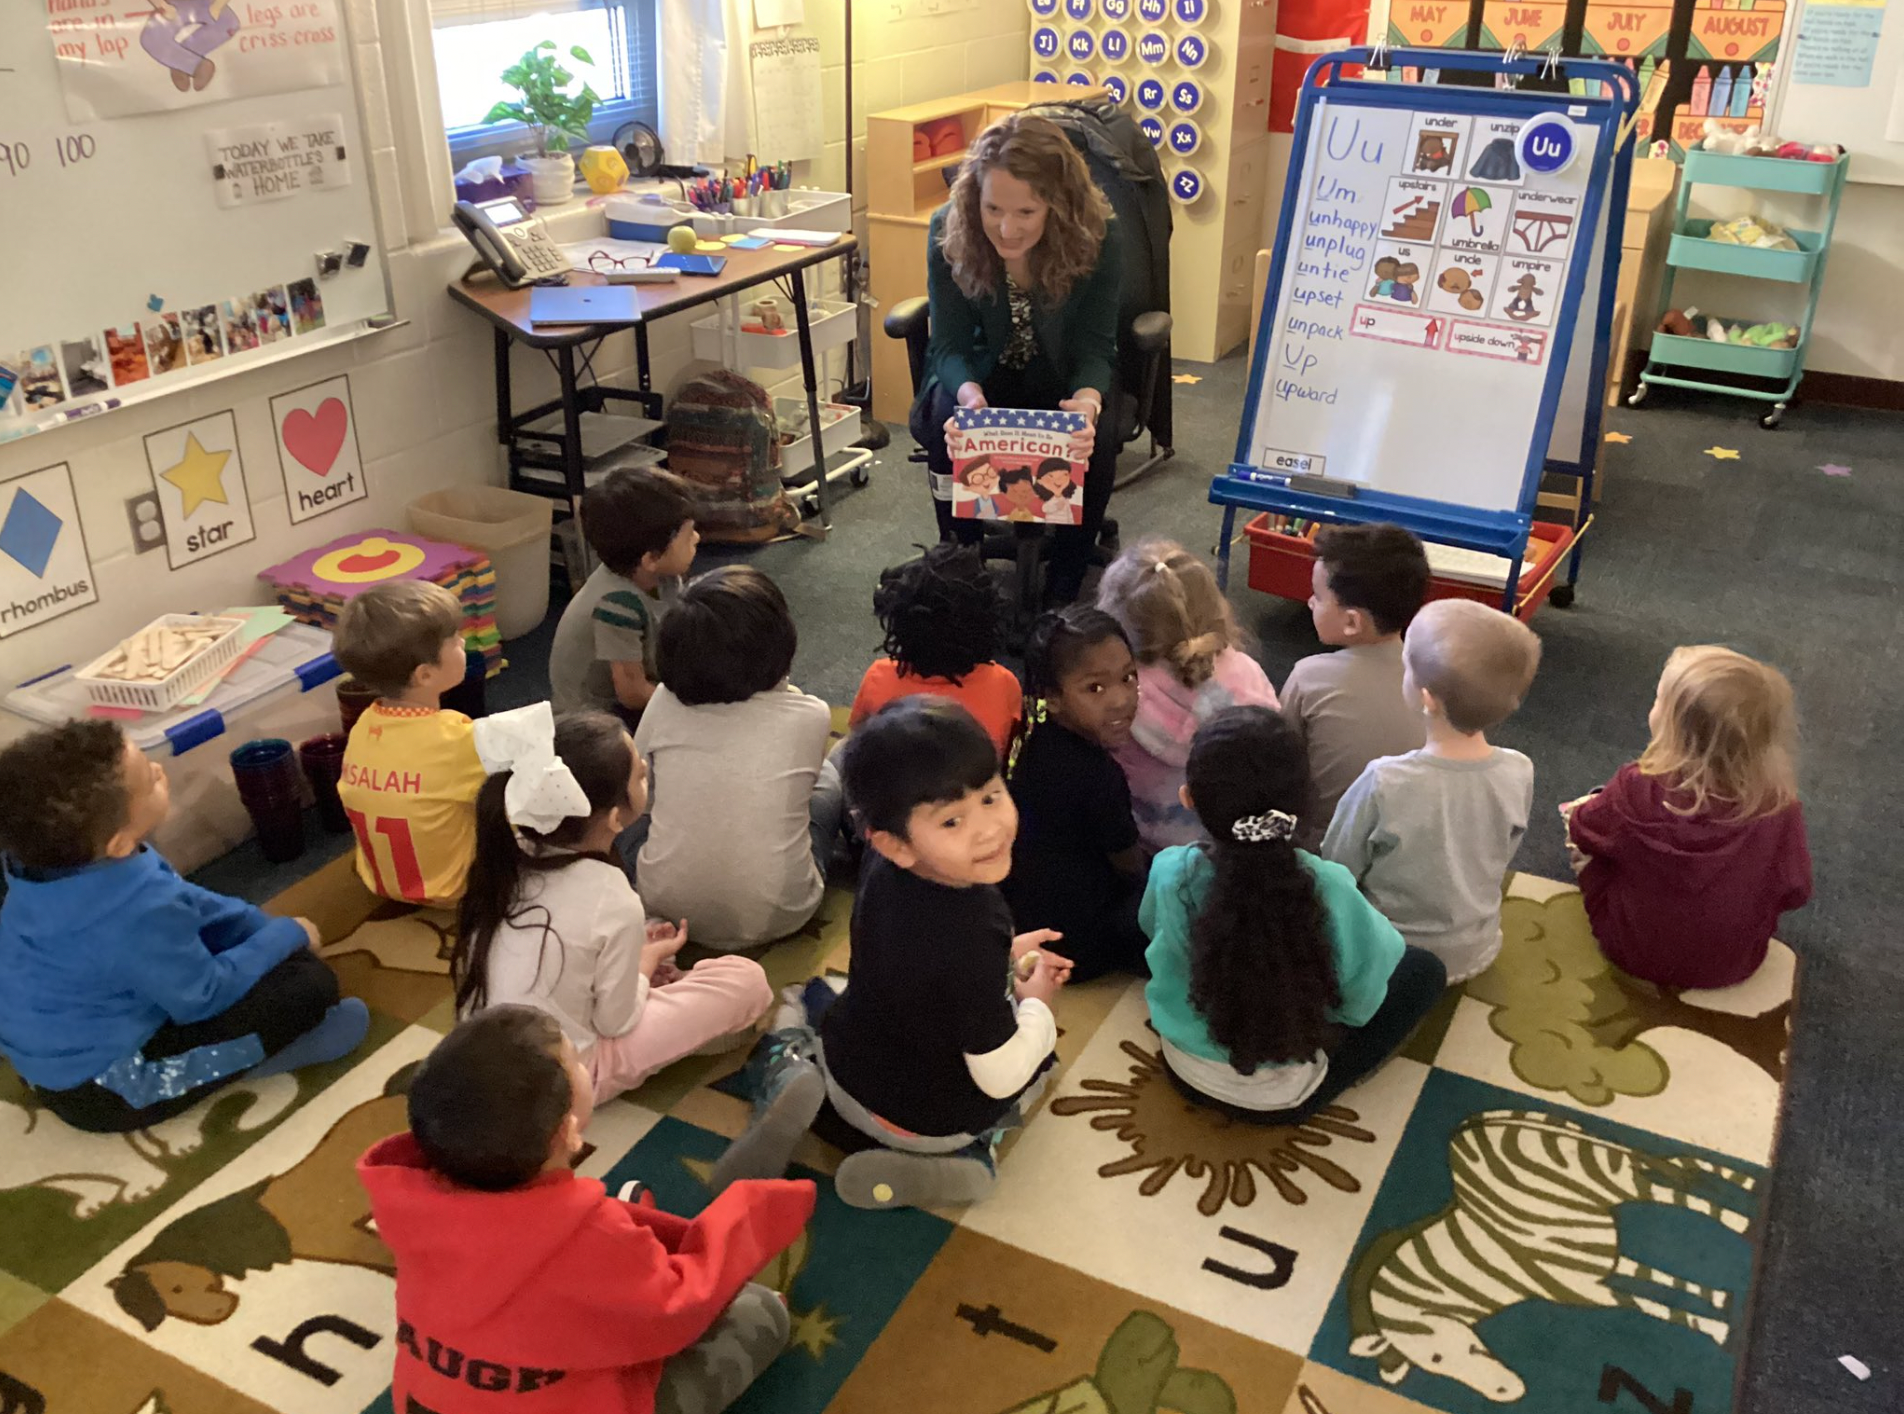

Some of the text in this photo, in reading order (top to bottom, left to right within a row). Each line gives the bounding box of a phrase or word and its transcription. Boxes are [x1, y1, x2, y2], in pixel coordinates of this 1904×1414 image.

[246, 3, 320, 29] legs are
[1410, 5, 1770, 37] MAY JUNE JULY AUGUST
[58, 33, 129, 67] my lap
[239, 26, 336, 53] criss cross
[1039, 35, 1053, 51] Jj
[1072, 37, 1089, 52] Kk
[1141, 41, 1163, 56] Mm
[1181, 40, 1198, 61] Nn
[1143, 87, 1157, 100] Rr
[1178, 88, 1193, 104] Ss
[1424, 116, 1458, 128] under
[1490, 122, 1520, 136] unzip
[218, 130, 335, 162] TODAY WE TAKE
[1176, 131, 1192, 144] Xx
[1326, 116, 1383, 164] Uu
[1532, 135, 1561, 158] Uu
[56, 133, 96, 169] 100
[252, 170, 301, 197] HOME
[1316, 175, 1356, 204] Um
[1398, 180, 1437, 192] upstairs
[1518, 191, 1577, 205] underwear
[1308, 209, 1378, 241] unhappy
[1304, 235, 1365, 271] unplug
[1398, 246, 1411, 257] us
[1452, 238, 1500, 251] umbrella
[1297, 261, 1350, 283] untie
[1454, 254, 1482, 265] uncle
[1512, 260, 1551, 272] umpire
[1293, 286, 1344, 309] upset
[1286, 316, 1344, 341] unpack
[1360, 316, 1375, 329] up
[1454, 333, 1515, 349] upside down
[1283, 343, 1318, 377] Up
[1276, 379, 1338, 405] upward
[1276, 454, 1312, 471] easel
[298, 472, 355, 512] heart
[186, 519, 234, 553] star
[1, 578, 90, 624] rhombus
[955, 1302, 1058, 1354] t
[250, 1314, 383, 1388] h
